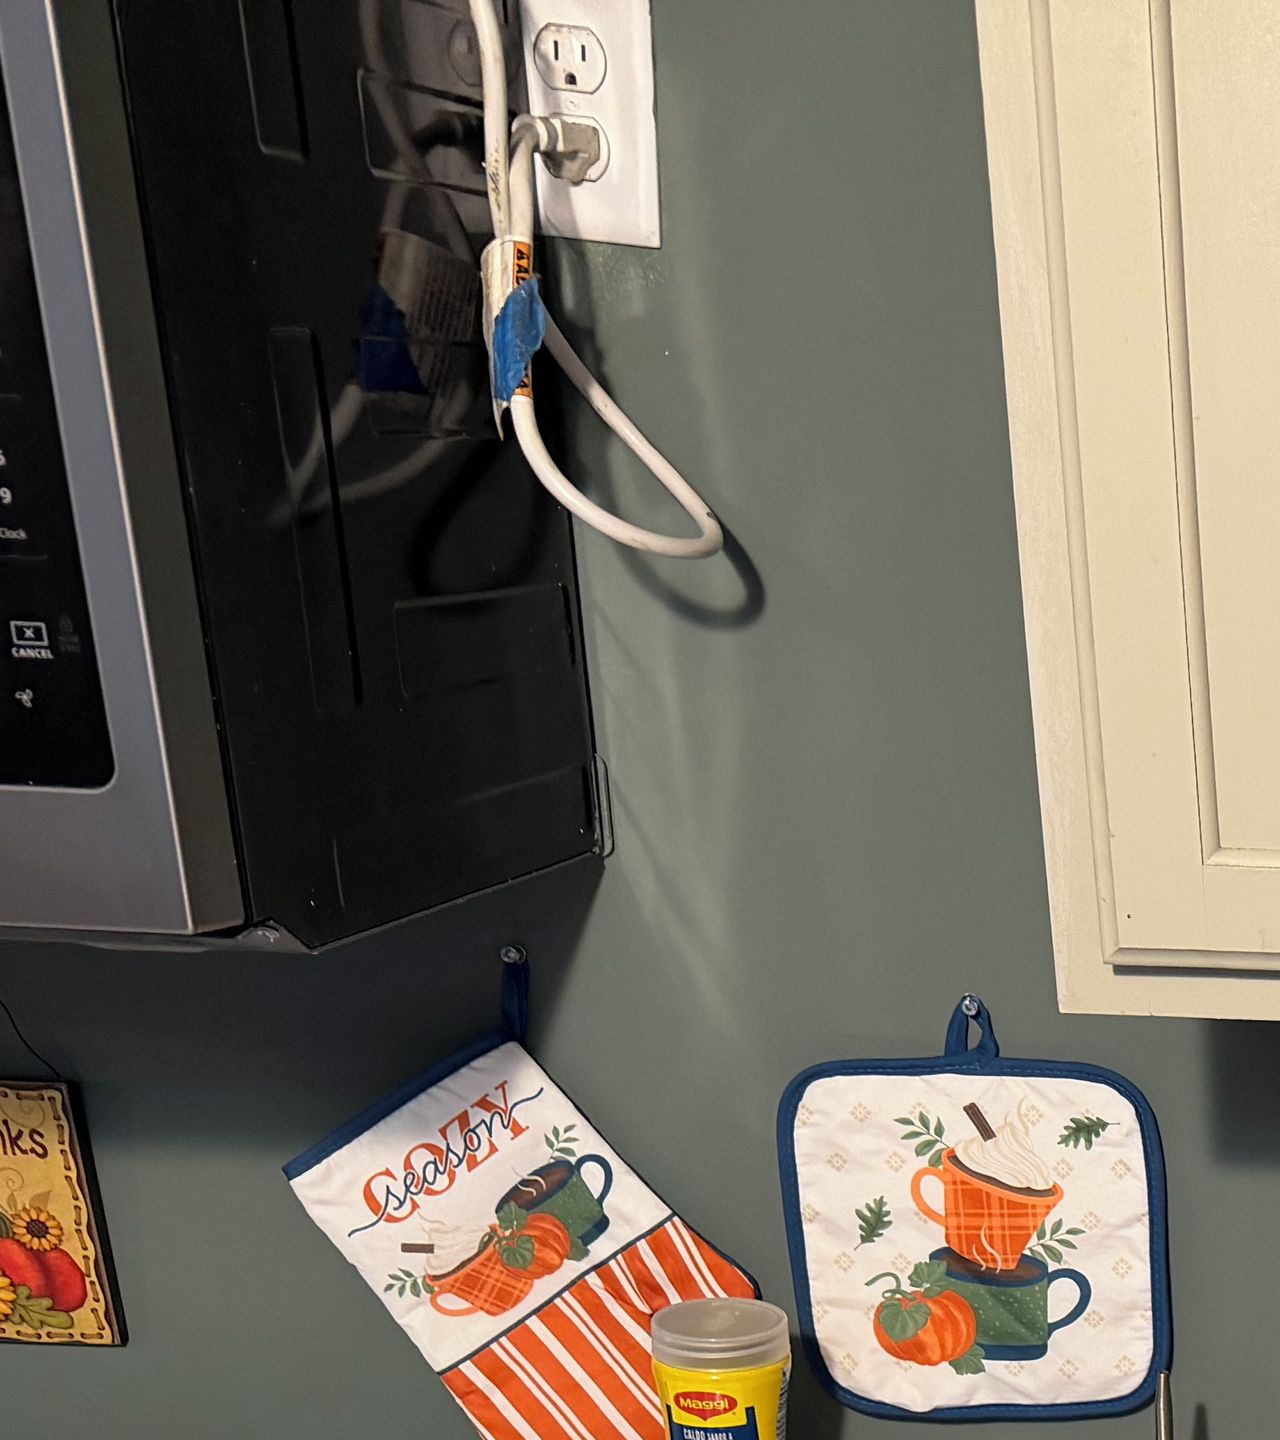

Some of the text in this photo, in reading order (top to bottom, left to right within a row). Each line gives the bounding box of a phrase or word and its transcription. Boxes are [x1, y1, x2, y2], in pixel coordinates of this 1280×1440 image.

[0, 487, 12, 504] 9
[11, 647, 54, 660] CANCEL
[363, 1080, 530, 1224] COZY
[368, 1095, 528, 1222] season
[679, 1396, 730, 1410] Maggi
[683, 1428, 706, 1440] CALDO
